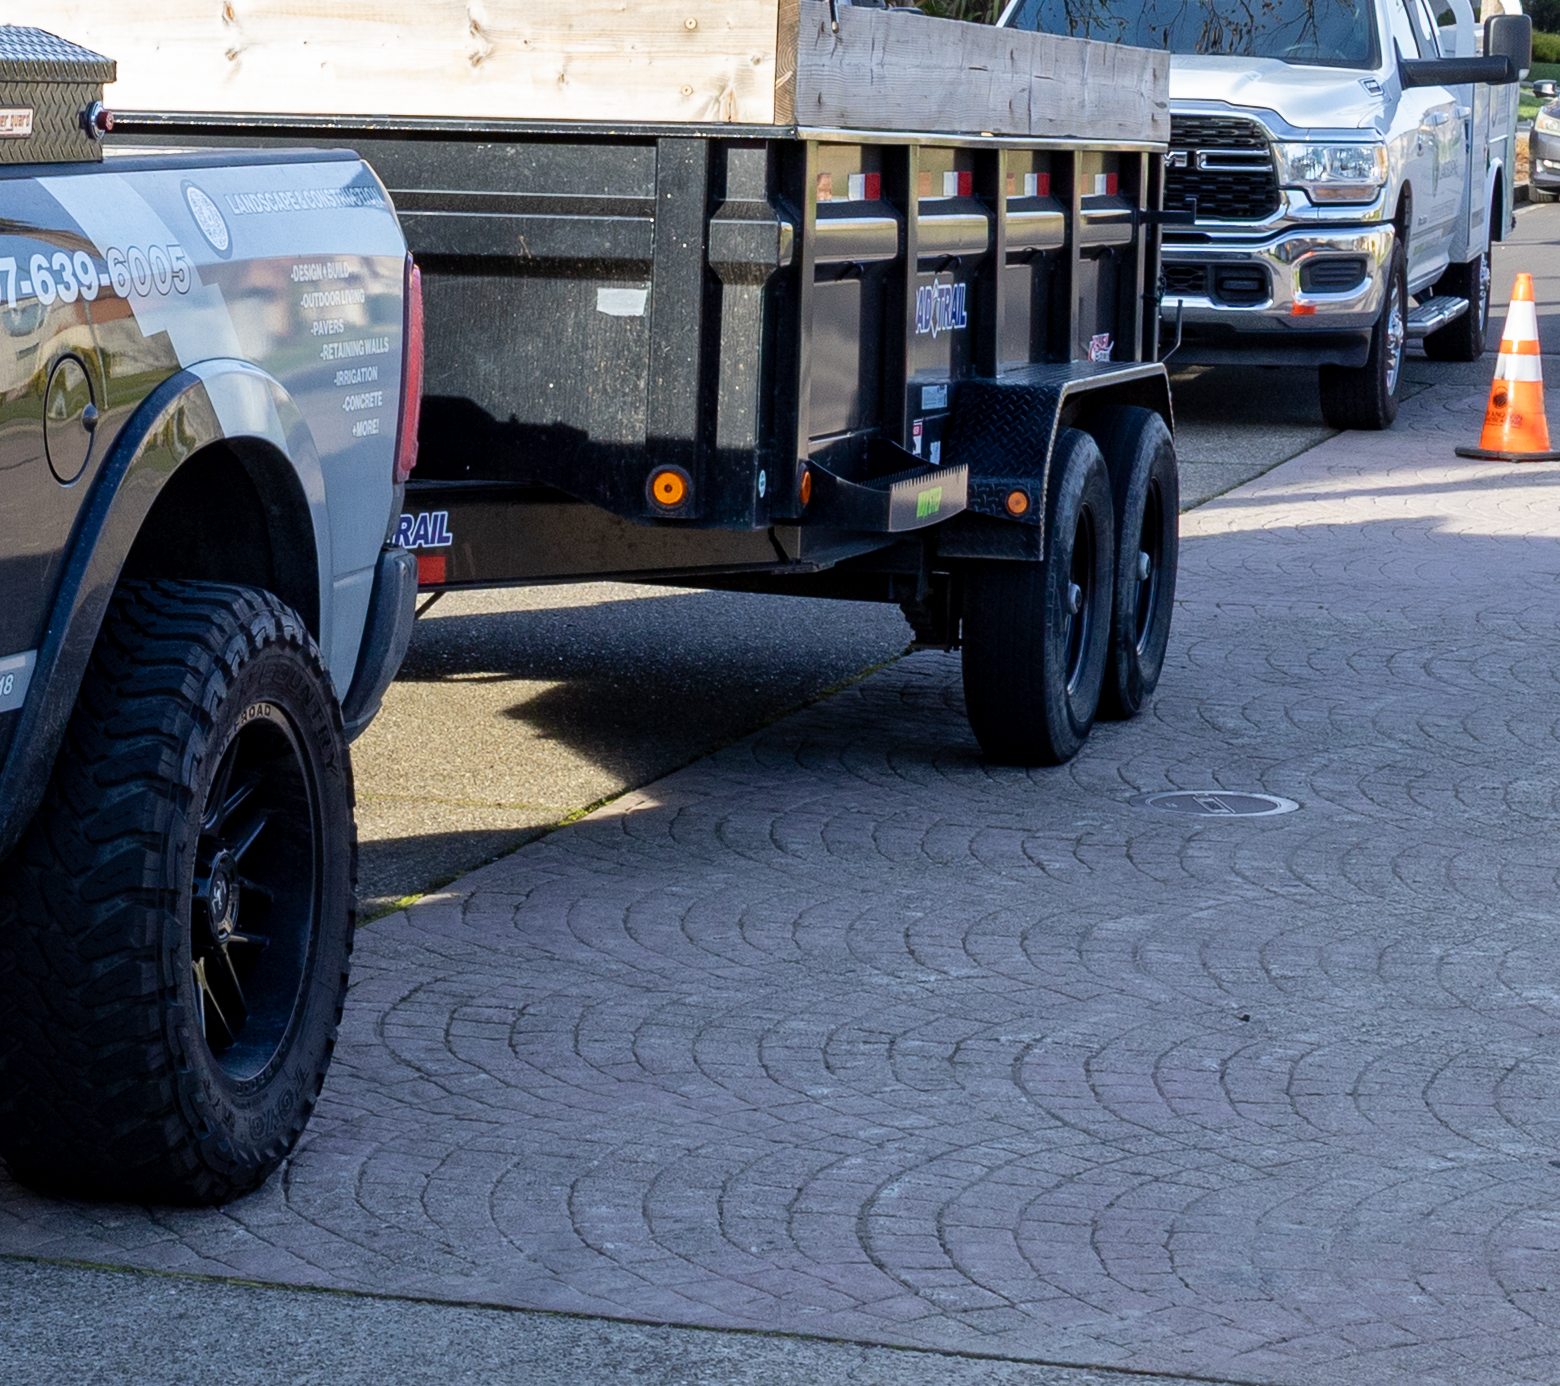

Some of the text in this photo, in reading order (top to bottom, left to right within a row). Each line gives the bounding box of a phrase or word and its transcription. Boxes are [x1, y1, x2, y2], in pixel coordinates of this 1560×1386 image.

[224, 191, 301, 217] LANDSCAPE
[306, 185, 386, 212] CONSTRUCTION
[340, 288, 366, 306] LIVING
[364, 336, 391, 357] WALLS
